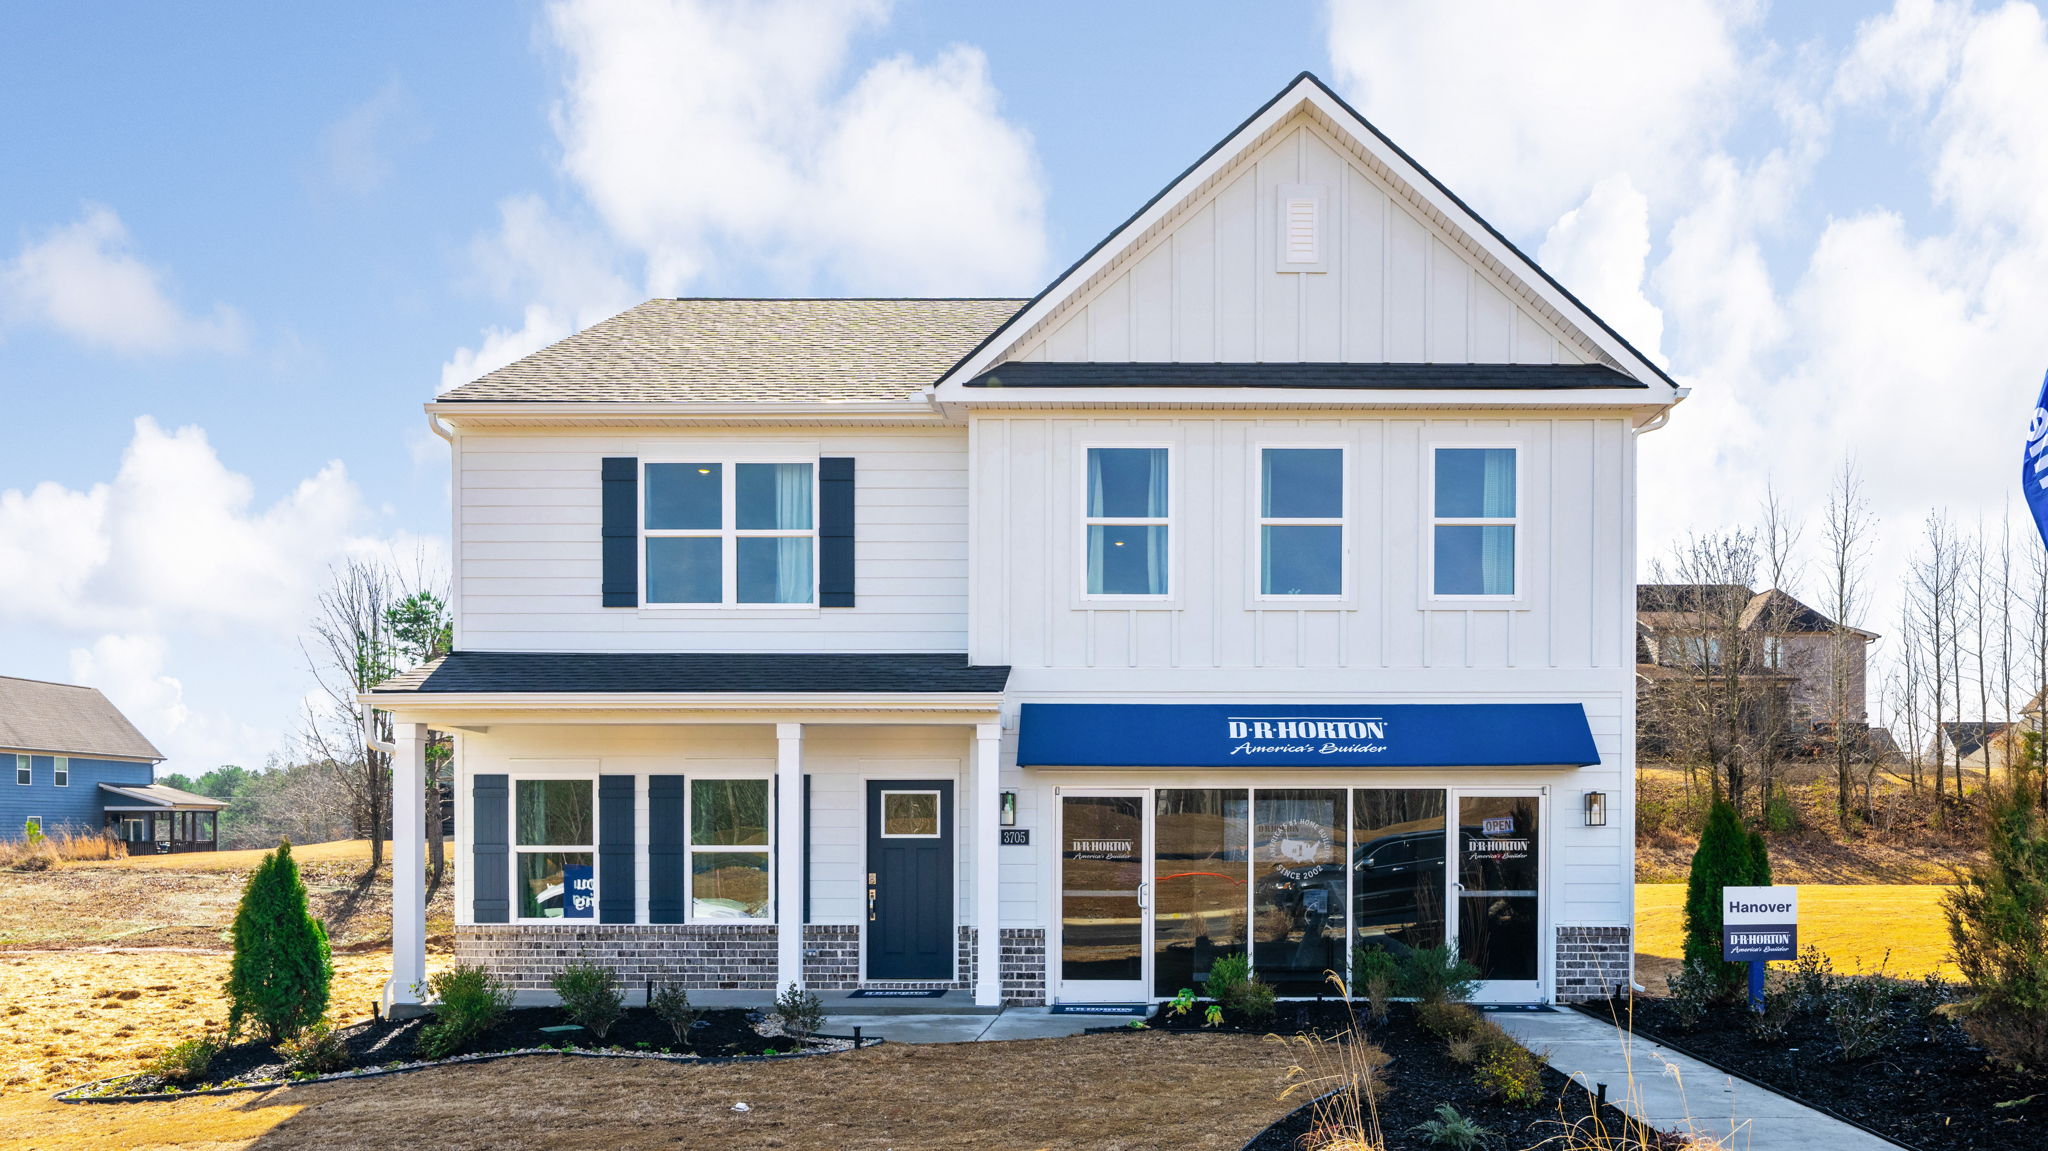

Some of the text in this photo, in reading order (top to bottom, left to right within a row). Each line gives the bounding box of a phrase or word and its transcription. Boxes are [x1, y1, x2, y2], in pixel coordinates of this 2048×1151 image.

[1230, 741, 1388, 755] America's Builder
[1300, 818, 1320, 830] HOME
[1486, 820, 1511, 832] OPEN
[1003, 831, 1026, 844] 3705
[1276, 864, 1324, 880] SINCE 2002
[1729, 901, 1792, 913] Hanover
[1763, 945, 1789, 953] Builder
